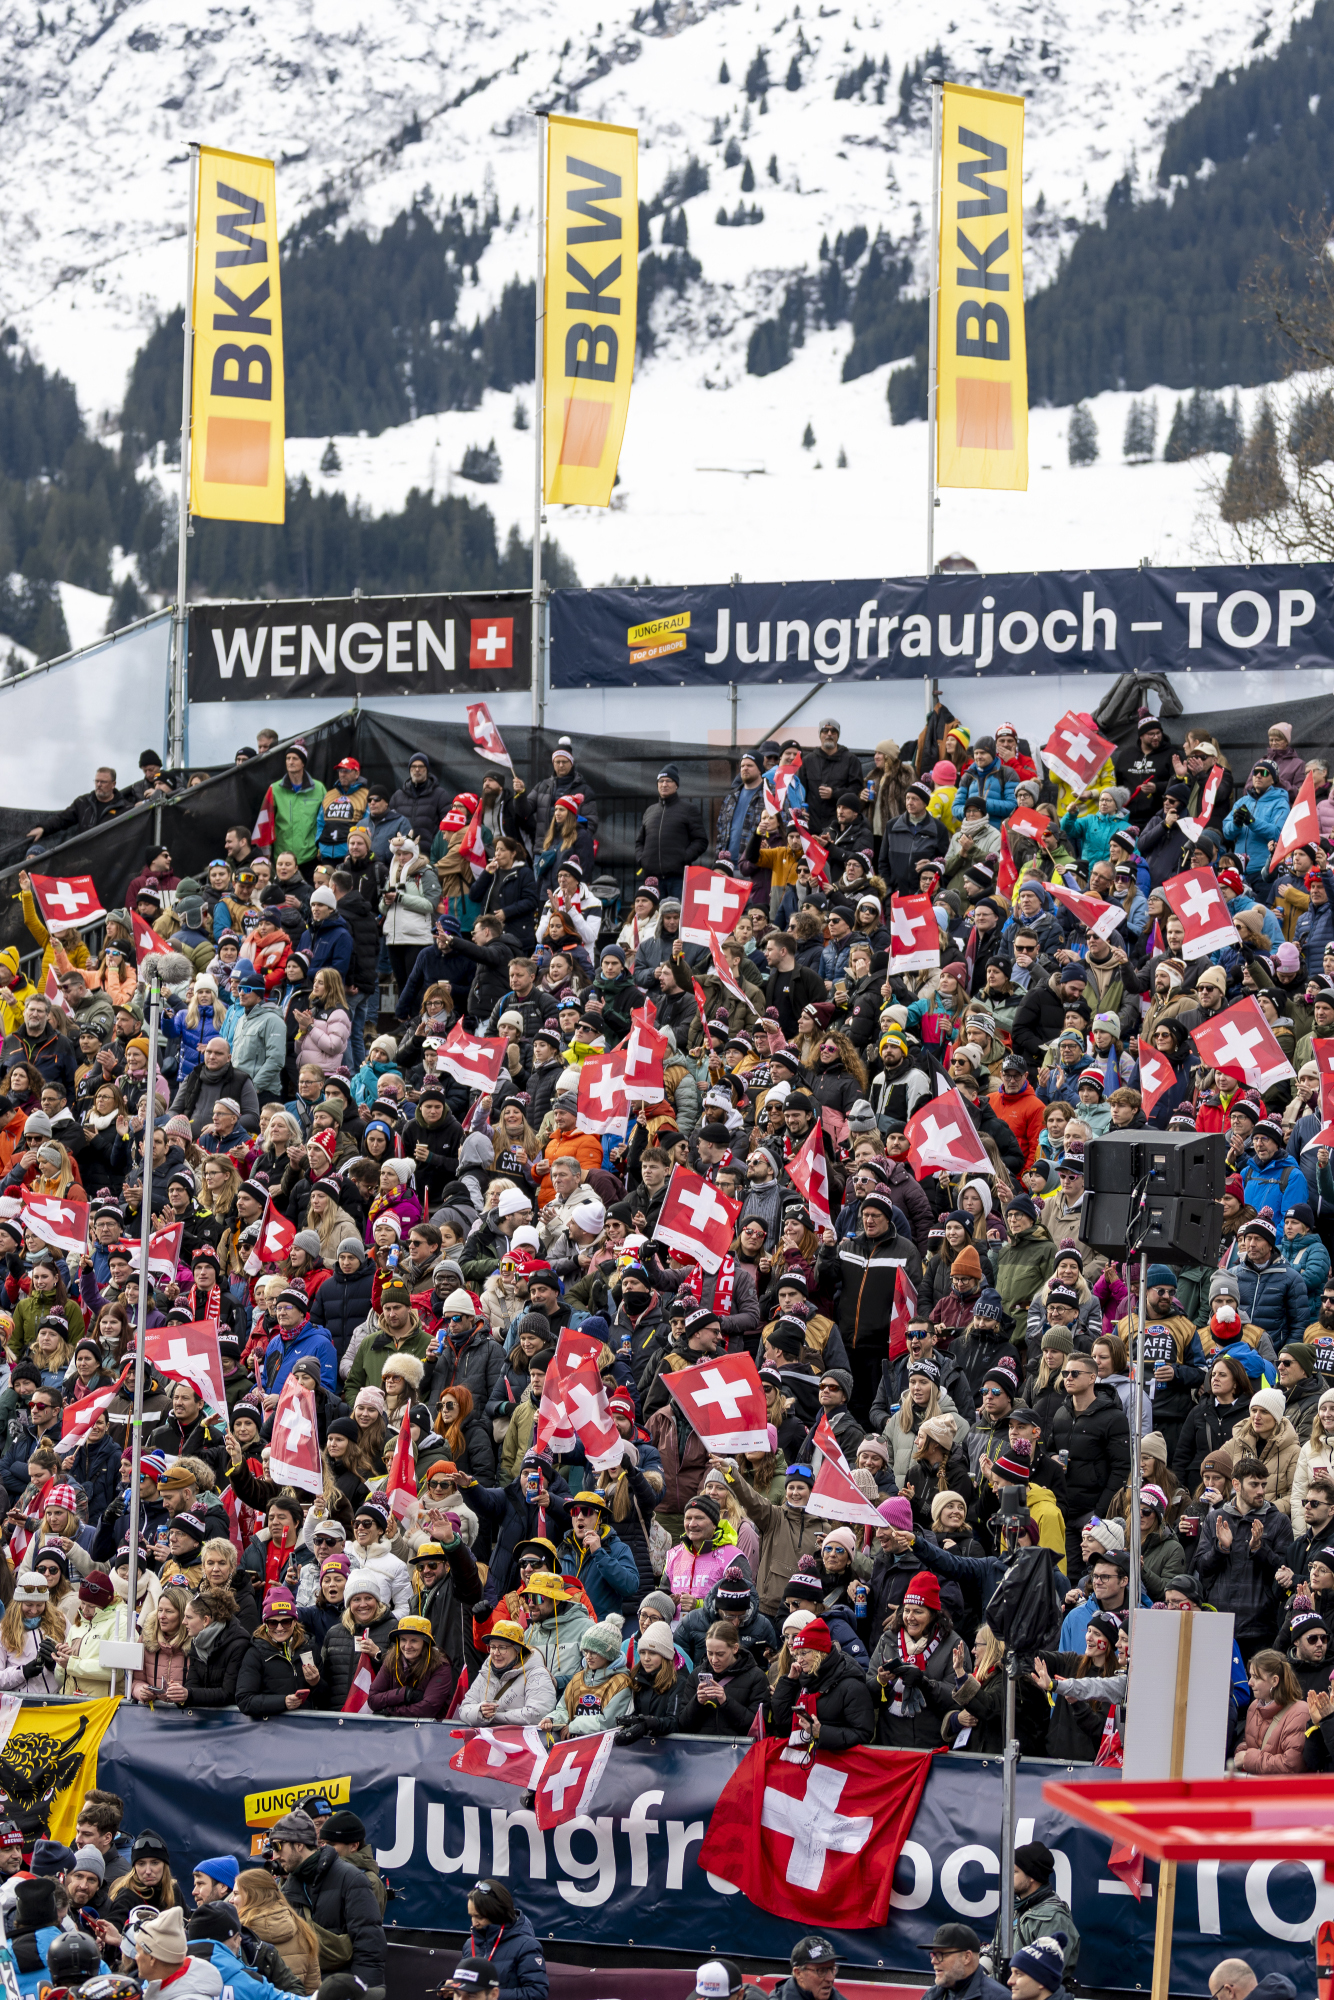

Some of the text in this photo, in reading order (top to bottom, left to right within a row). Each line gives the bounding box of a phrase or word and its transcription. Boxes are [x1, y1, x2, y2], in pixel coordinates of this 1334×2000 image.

[957, 127, 1010, 361] BKW
[565, 157, 621, 382] BKW
[211, 181, 272, 401] BKW
[634, 617, 684, 639] JUNGFRAU
[705, 591, 1117, 675] Jungfraujoch
[1176, 590, 1316, 649] TOP
[212, 619, 455, 679] WENGEN
[633, 640, 683, 660] TOP OF EUROPE
[327, 810, 350, 818] LATTE
[503, 1152, 517, 1160] CAF
[502, 1161, 521, 1170] LATT
[976, 1303, 1000, 1320] HH
[1144, 1337, 1172, 1348] AFFÈ
[1143, 1349, 1171, 1359] ATTE
[673, 1575, 710, 1587] STAFF
